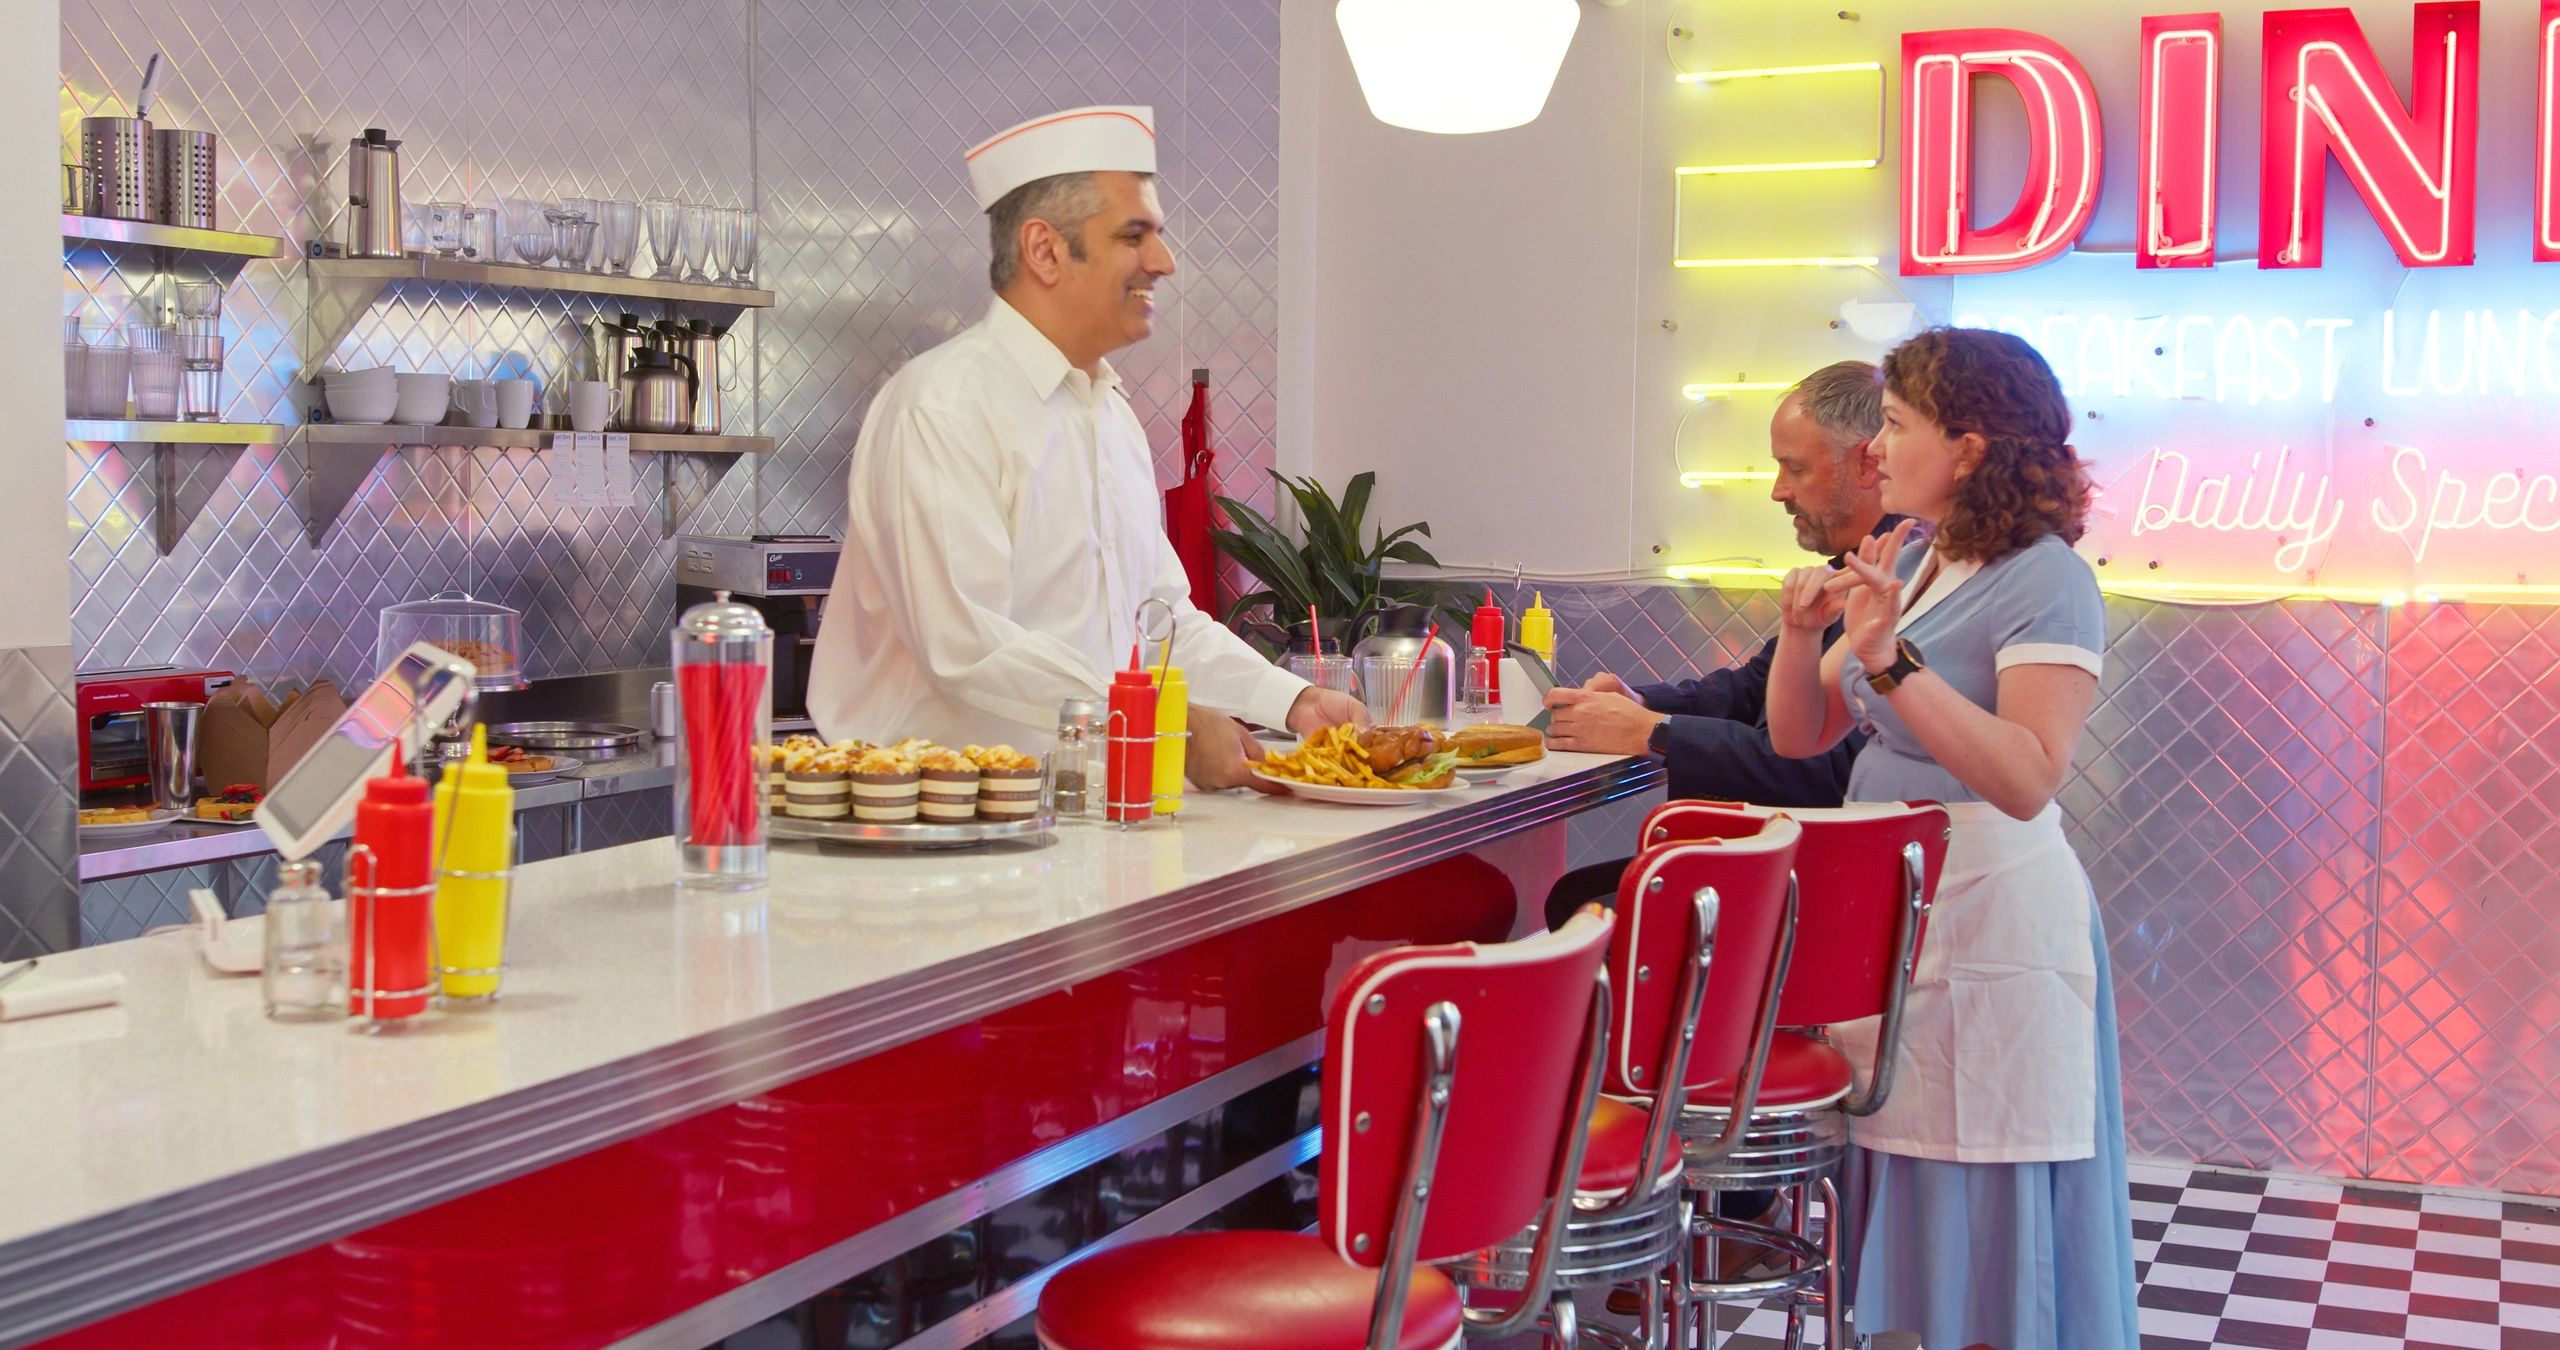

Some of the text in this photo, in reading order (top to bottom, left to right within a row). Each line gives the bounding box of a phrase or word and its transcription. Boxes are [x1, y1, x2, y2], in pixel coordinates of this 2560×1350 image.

[1900, 0, 2560, 277] DIN
[1955, 313, 2354, 405] EAKFAST
[2131, 444, 2560, 573] Daily Spec
